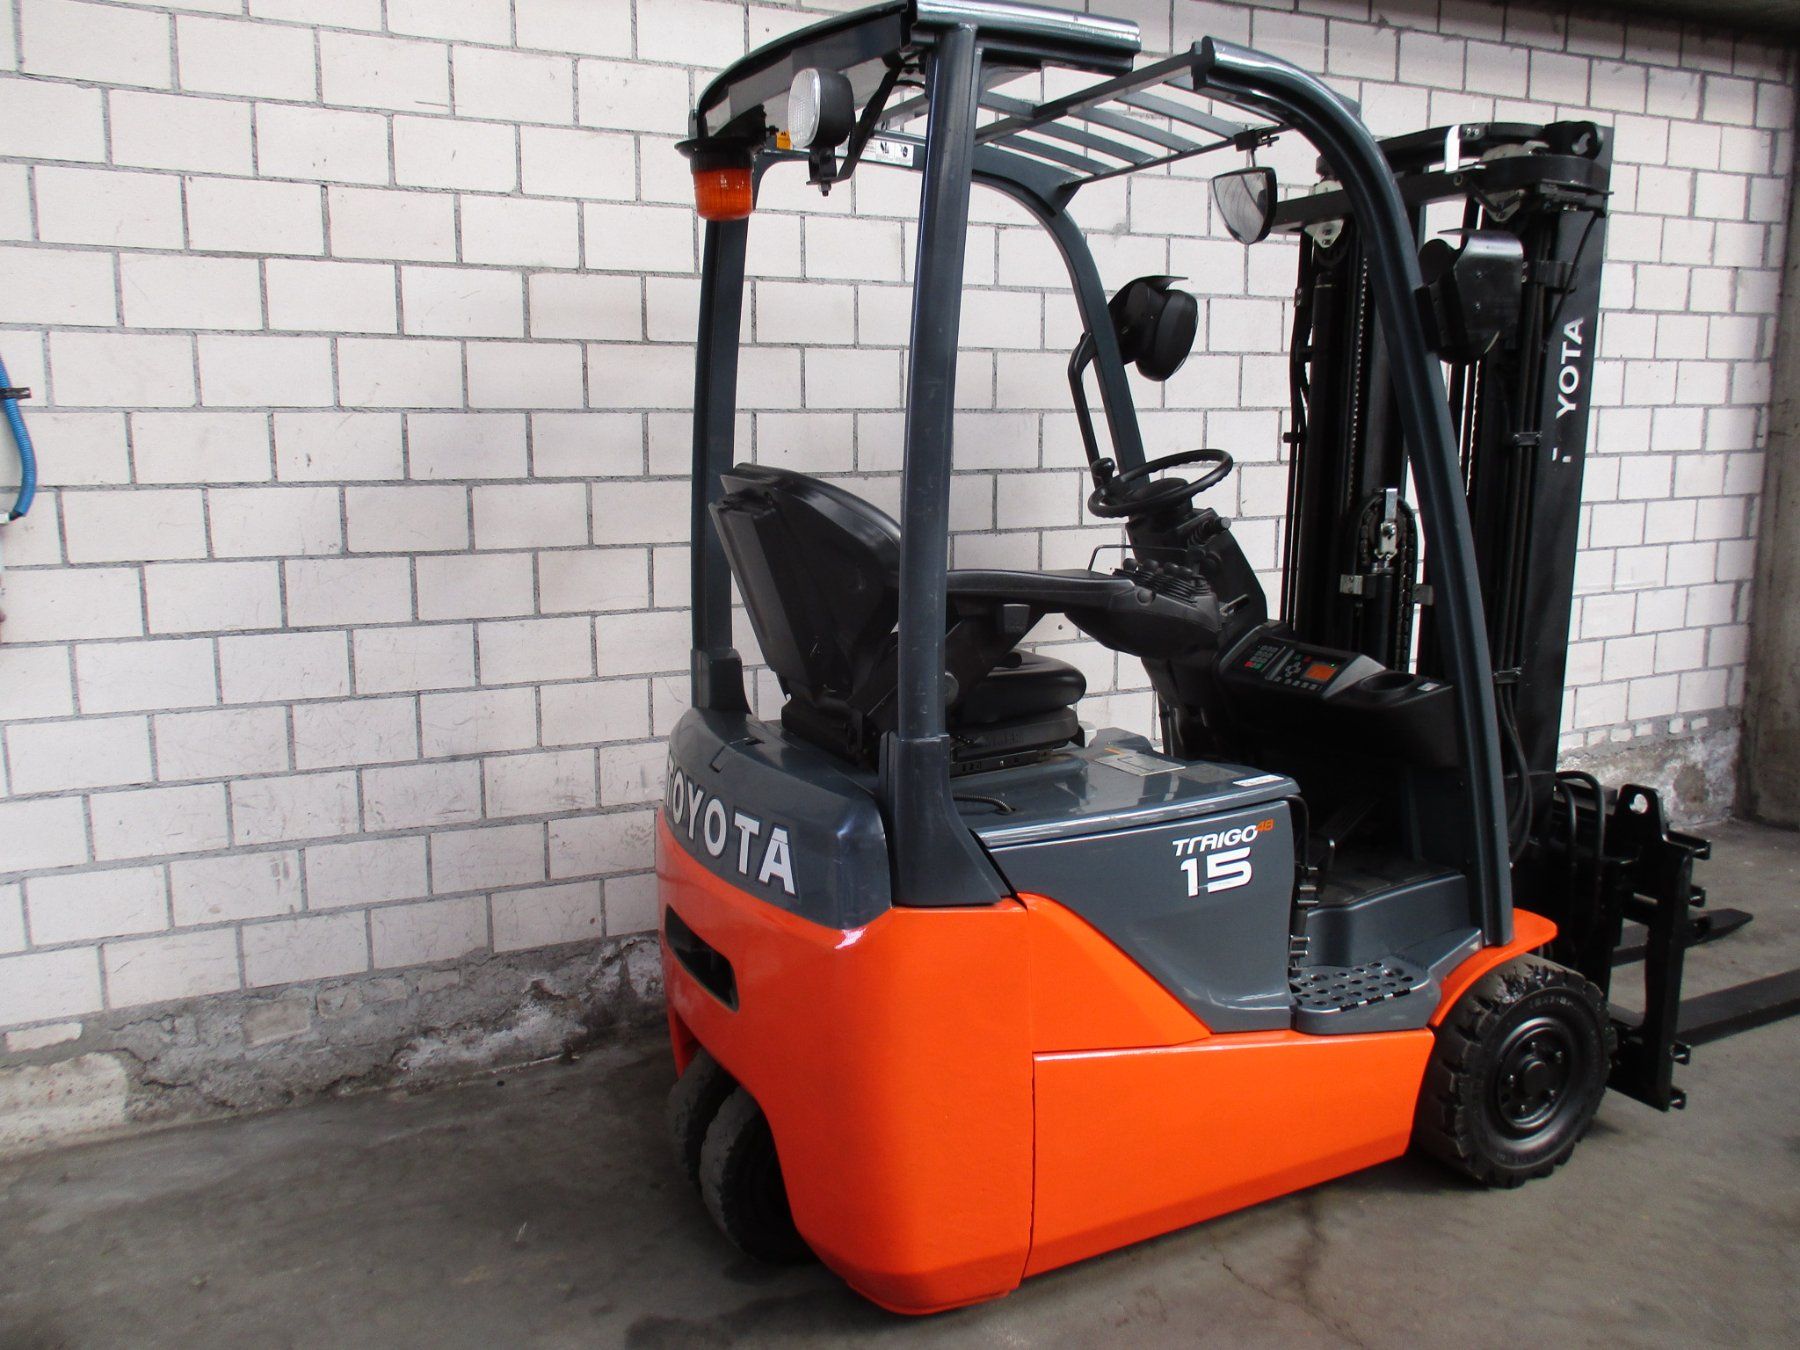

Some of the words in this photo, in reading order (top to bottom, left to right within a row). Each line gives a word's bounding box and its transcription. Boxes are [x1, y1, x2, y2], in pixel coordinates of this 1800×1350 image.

[1172, 824, 1258, 857] TRAIGO
[1255, 818, 1274, 832] 48
[1180, 846, 1252, 897] 15
